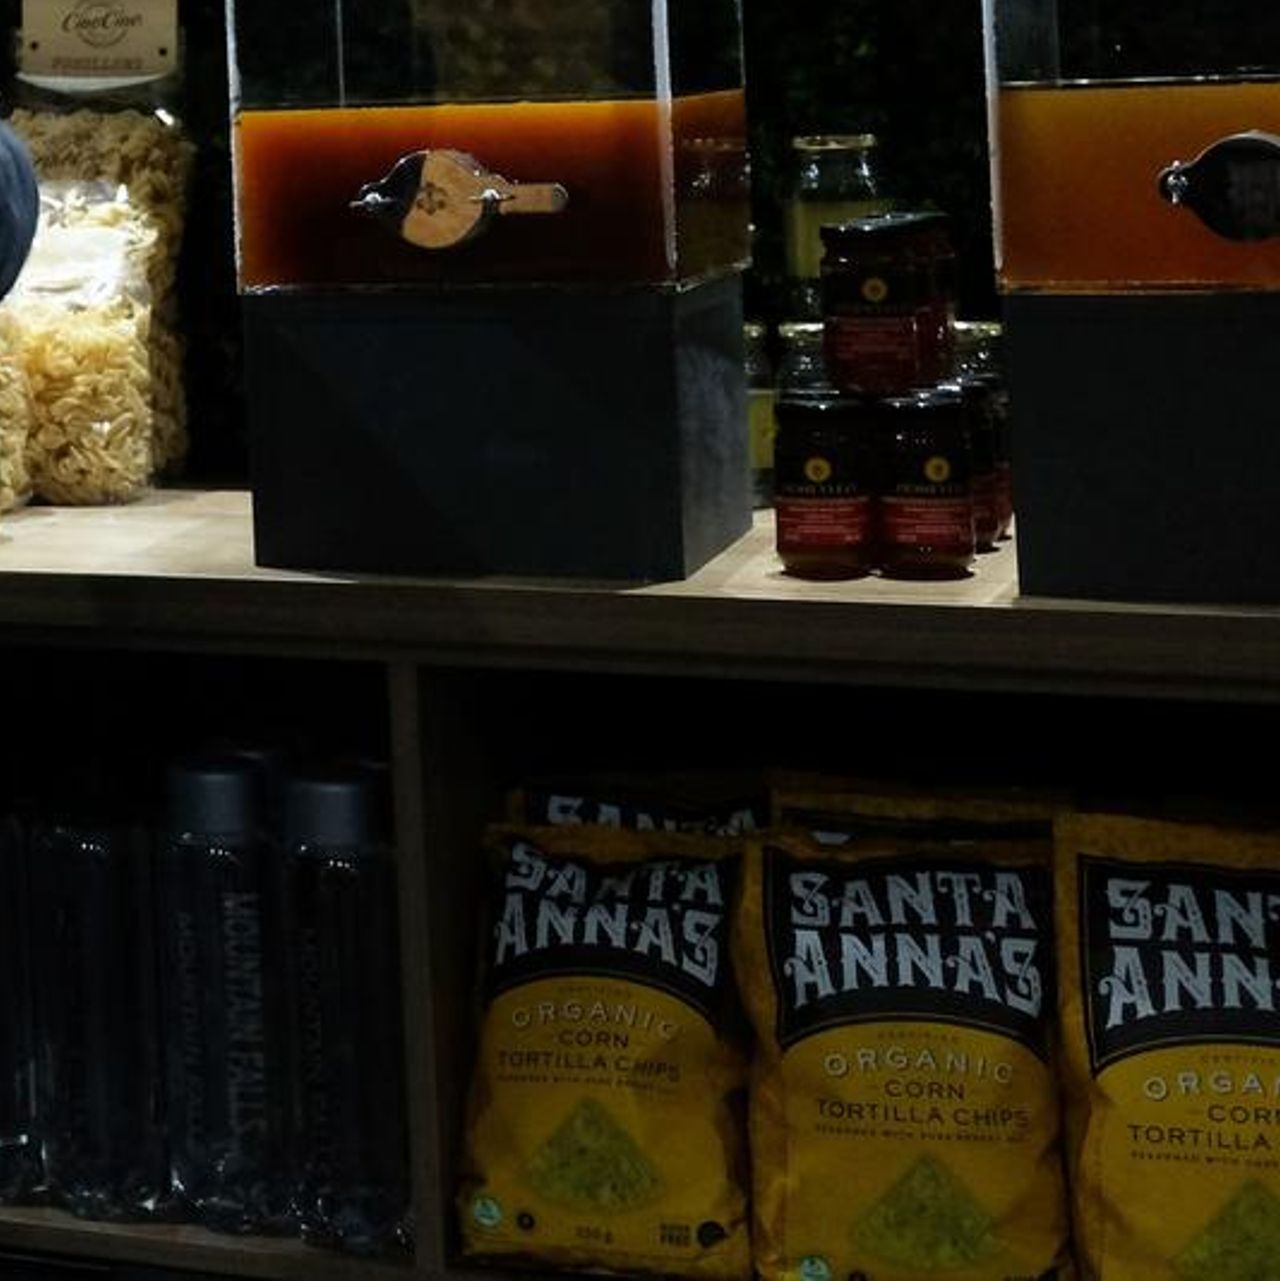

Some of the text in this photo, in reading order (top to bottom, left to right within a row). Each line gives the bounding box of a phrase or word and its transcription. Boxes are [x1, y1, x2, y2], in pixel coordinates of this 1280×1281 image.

[789, 871, 1038, 931] SANTA
[782, 926, 1042, 1020] ANNA'S
[1098, 942, 1280, 1032] ANN
[511, 999, 681, 1040] ORGANIC
[557, 1027, 631, 1050] CORN
[495, 1048, 681, 1083] TORTILLA CHIPS
[823, 1046, 1013, 1085] ORGANIC
[883, 1078, 966, 1101] CORN
[814, 1097, 1031, 1130] TORTILLA CHIPS
[1127, 1123, 1273, 1152] TORTILLA
